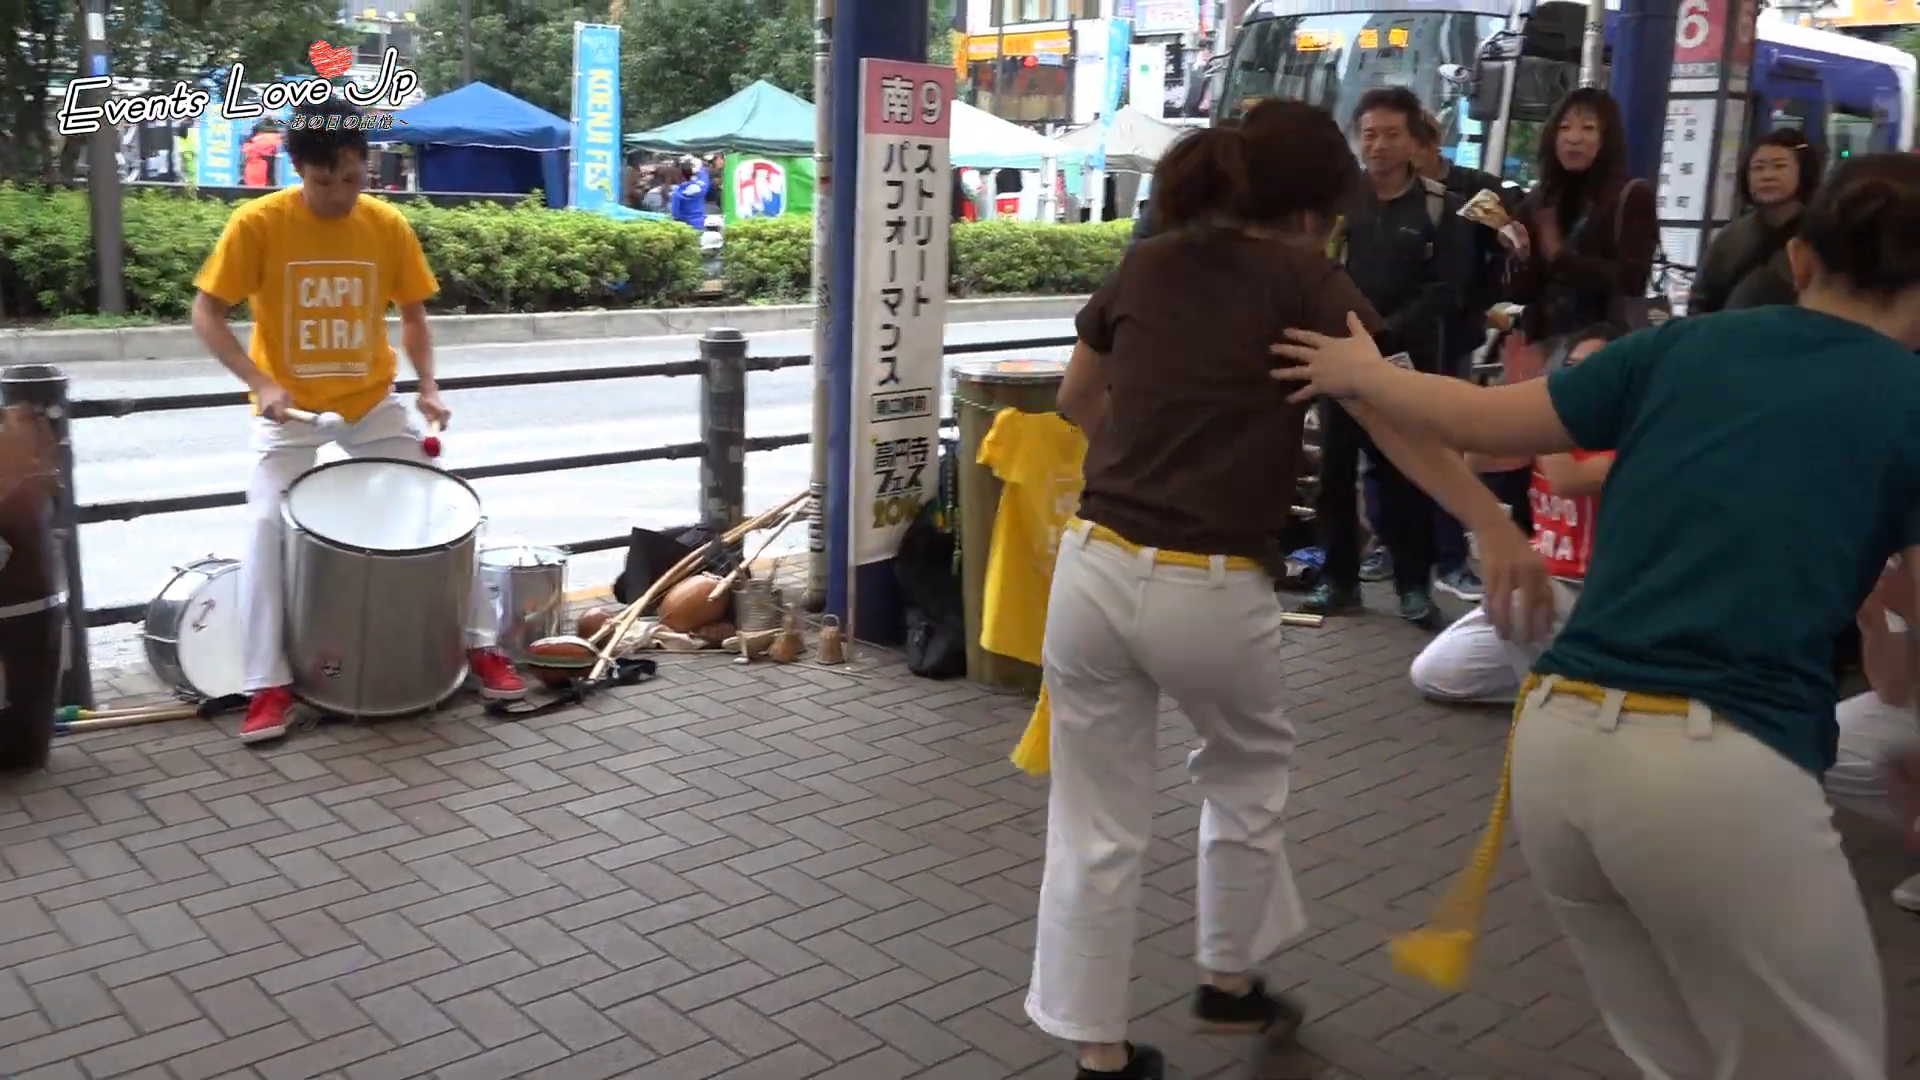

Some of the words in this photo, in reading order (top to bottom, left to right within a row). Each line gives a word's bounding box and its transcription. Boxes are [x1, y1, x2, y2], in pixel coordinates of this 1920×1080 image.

[1675, 0, 1709, 48] 6
[587, 68, 614, 144] KOENJI
[881, 74, 942, 125] 南9
[913, 143, 938, 317] ストリート
[877, 141, 911, 387] パフォーマンス
[299, 318, 367, 350] EIRA
[873, 436, 930, 471] 高円寺
[873, 463, 928, 495] フェス
